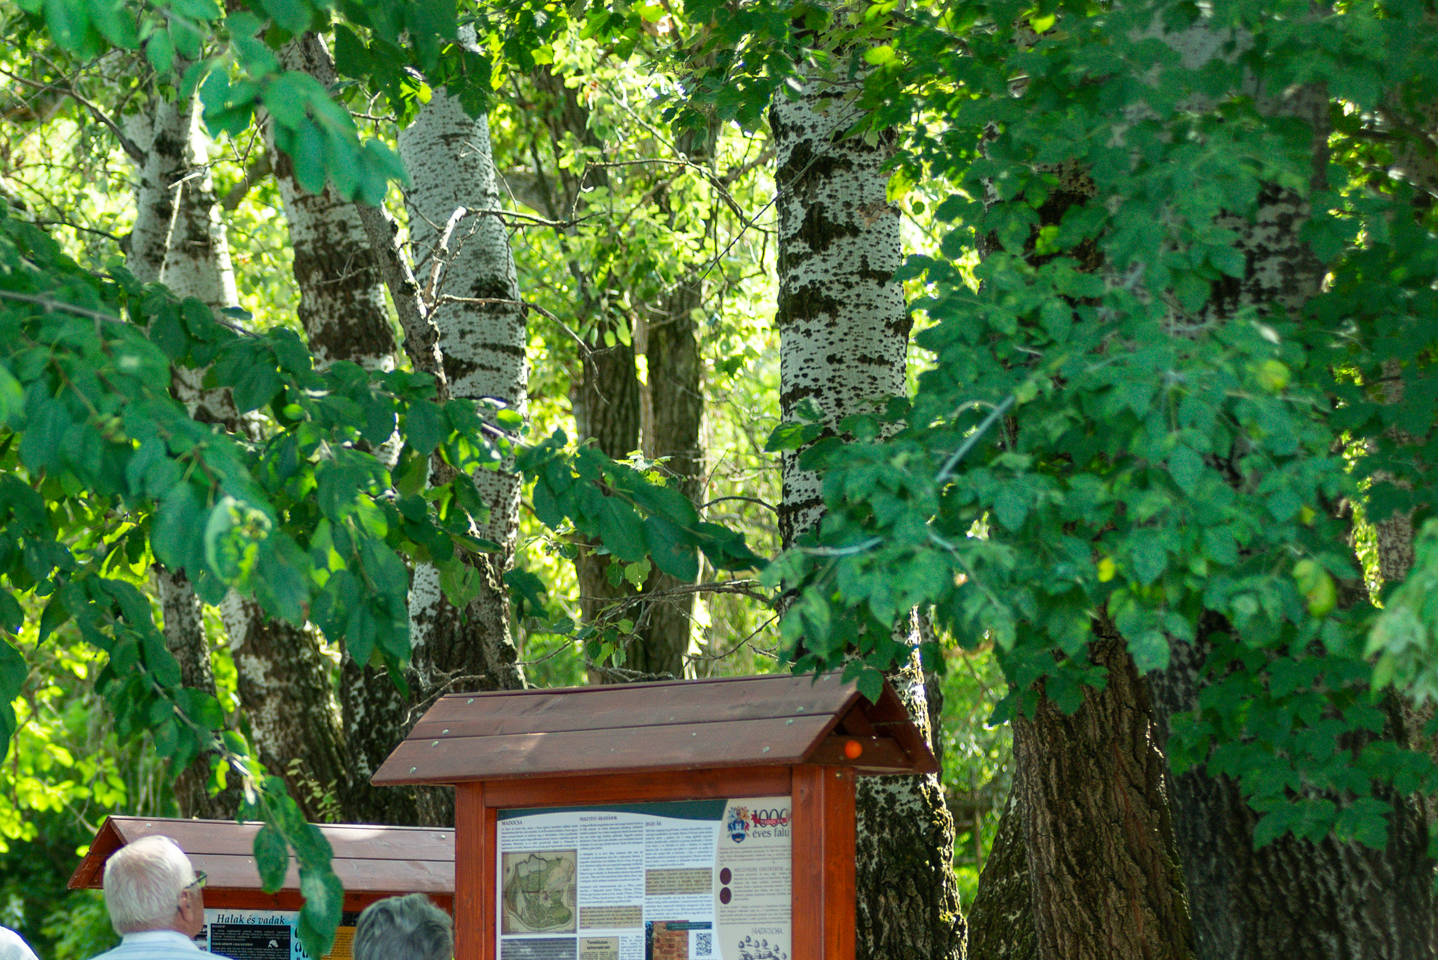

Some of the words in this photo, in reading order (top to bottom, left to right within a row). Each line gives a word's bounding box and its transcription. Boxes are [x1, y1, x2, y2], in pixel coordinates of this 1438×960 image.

[752, 829, 772, 838] éves
[774, 827, 790, 838] falu
[217, 914, 245, 924] Halak
[246, 914, 256, 924] és
[258, 915, 285, 925] vadak
